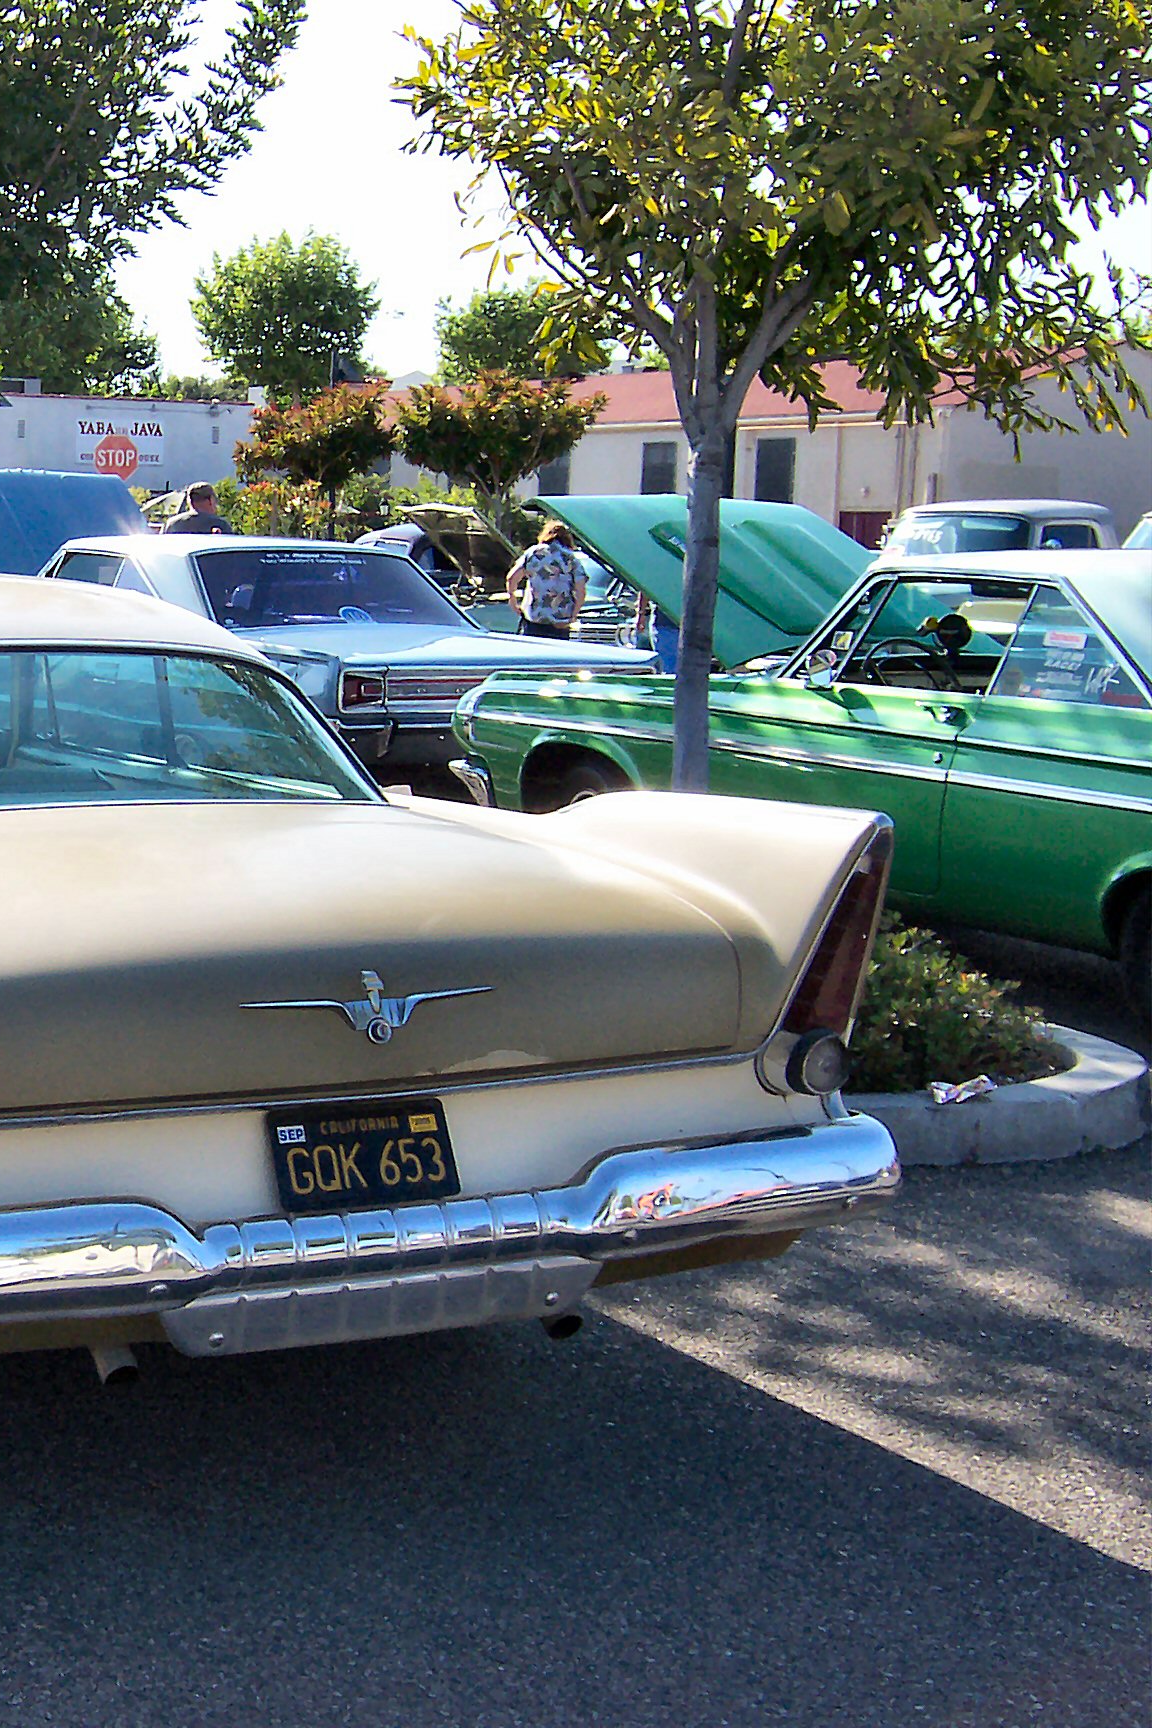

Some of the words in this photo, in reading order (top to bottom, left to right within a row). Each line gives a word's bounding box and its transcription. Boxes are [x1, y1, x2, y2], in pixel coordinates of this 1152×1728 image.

[78, 420, 115, 435] YABA
[130, 422, 163, 437] JAVA
[97, 449, 135, 467] STOP
[139, 454, 160, 462] OUSE
[320, 1115, 399, 1135] CALIFORNIA
[279, 1128, 304, 1142] SEP
[379, 1136, 447, 1187] 653
